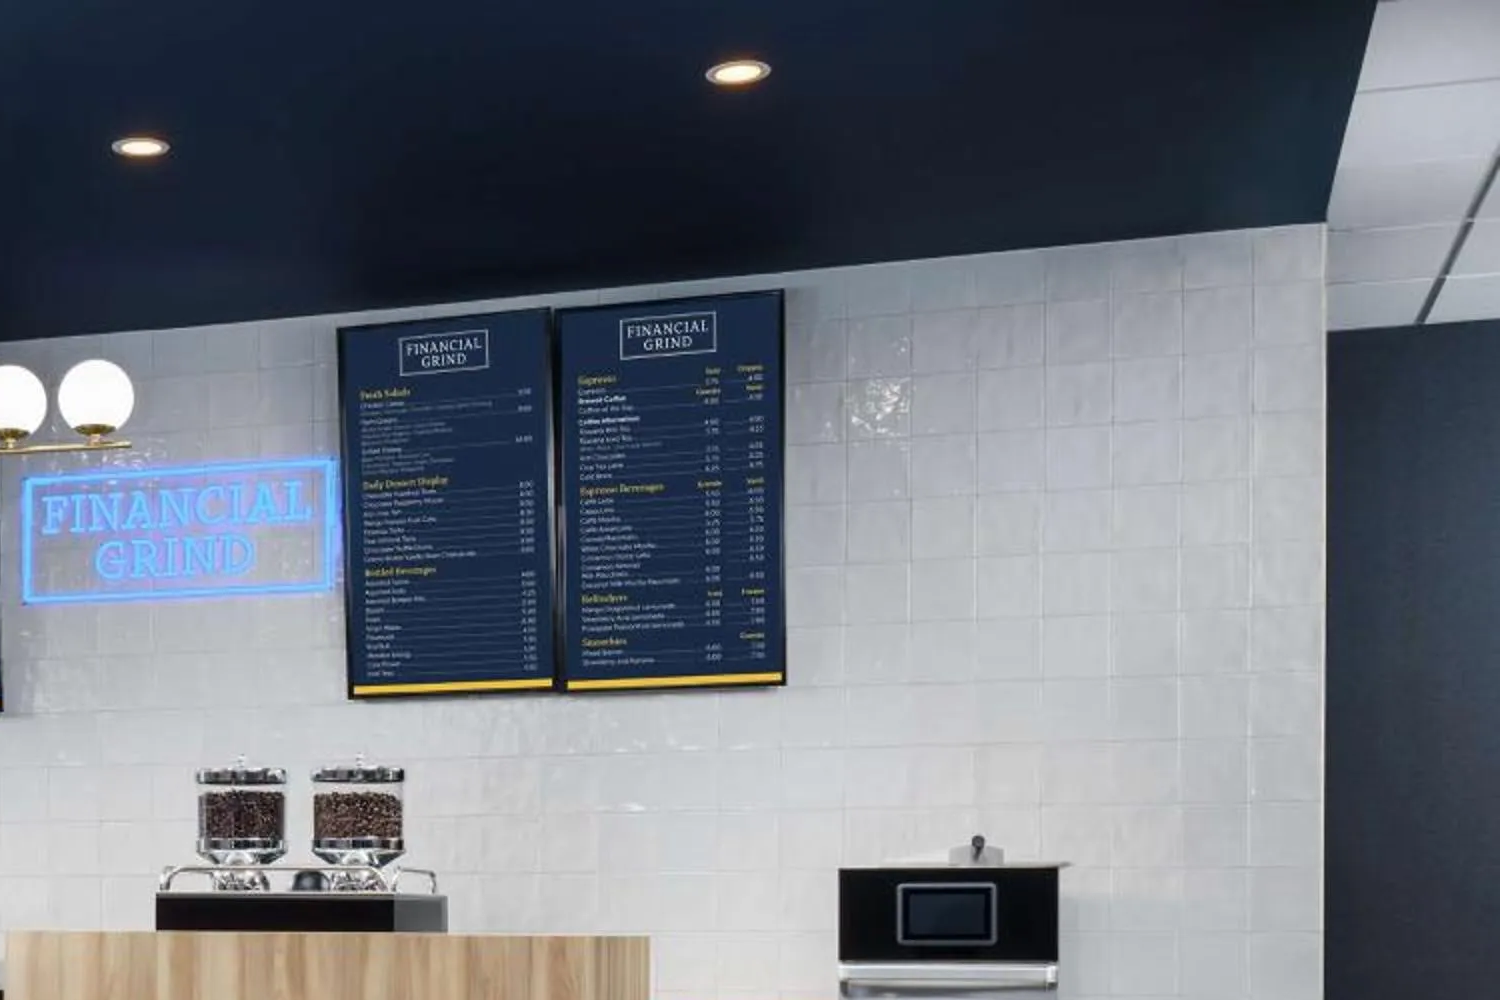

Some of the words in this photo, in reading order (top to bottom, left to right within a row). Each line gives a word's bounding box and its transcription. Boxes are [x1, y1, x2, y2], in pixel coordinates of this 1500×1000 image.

[627, 319, 708, 338] FINANCIAL
[406, 337, 482, 356] FINANCIAL
[643, 335, 692, 351] GRIND
[421, 353, 467, 368] GRIND
[40, 480, 314, 535] FINANCIAL
[94, 533, 257, 582] GRIND
